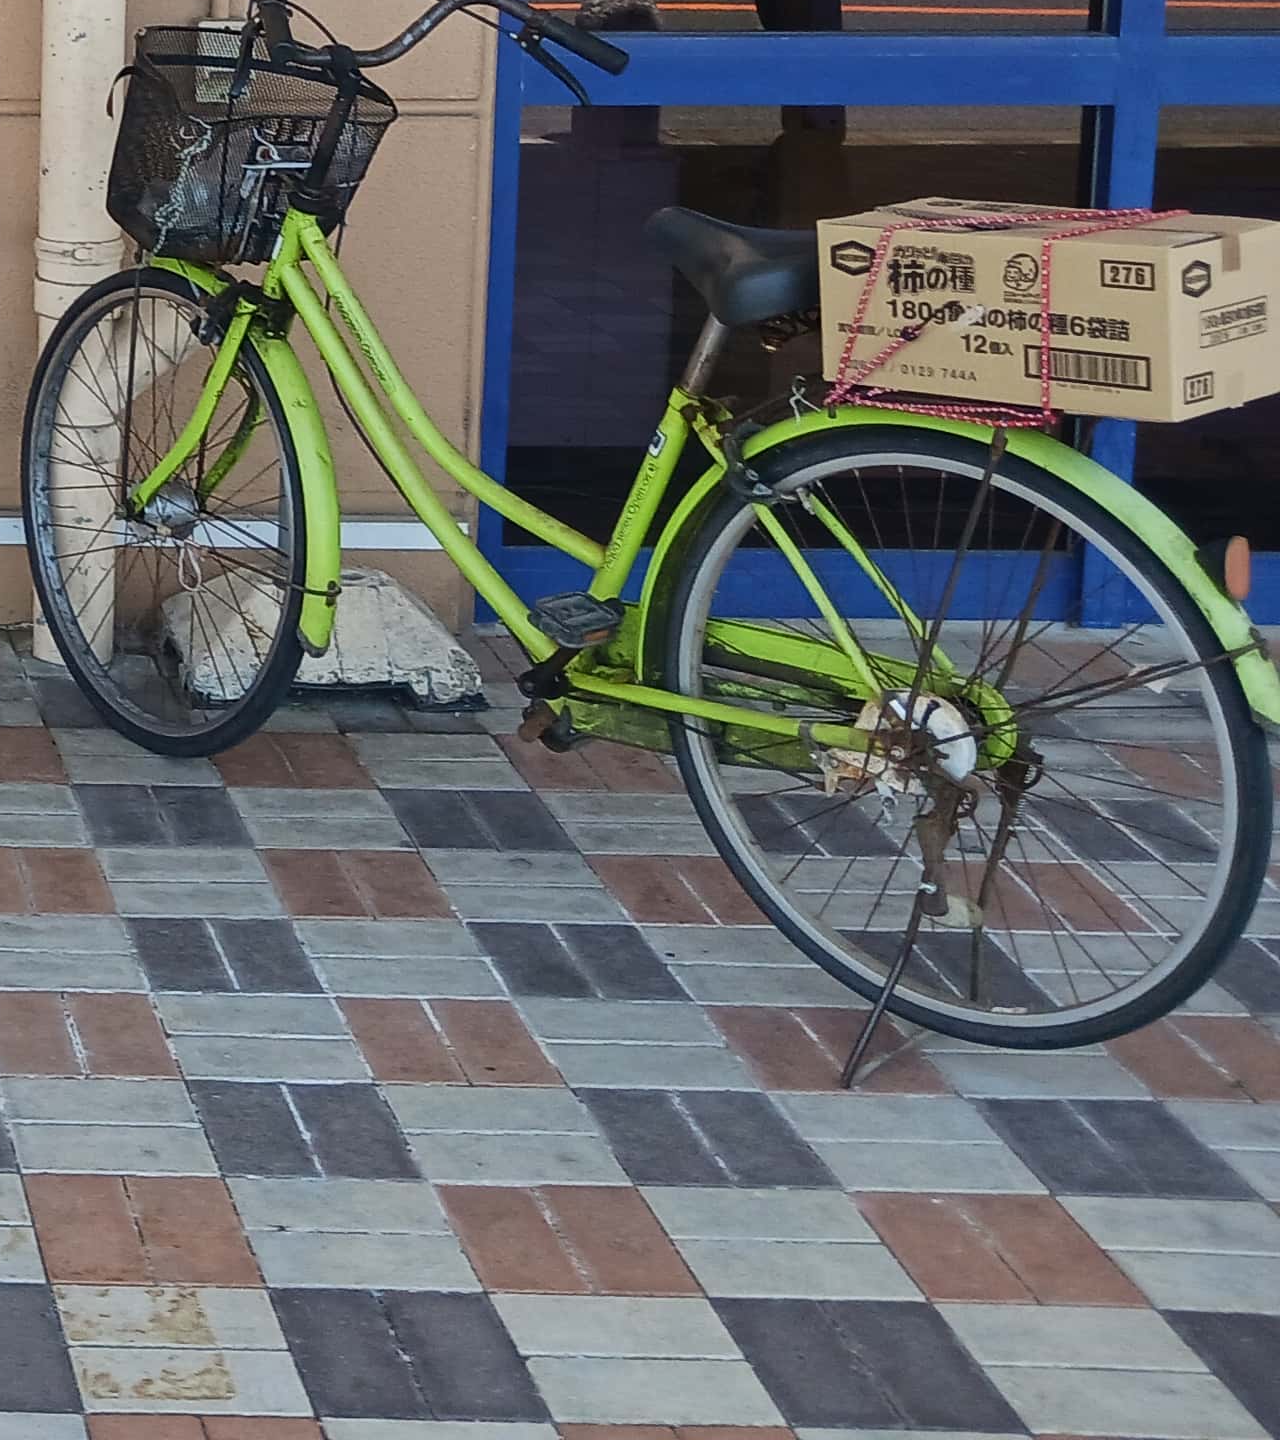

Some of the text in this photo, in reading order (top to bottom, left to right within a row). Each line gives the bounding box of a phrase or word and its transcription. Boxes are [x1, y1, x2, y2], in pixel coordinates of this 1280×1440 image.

[886, 259, 976, 296] 柿の種
[1110, 265, 1146, 286] 276
